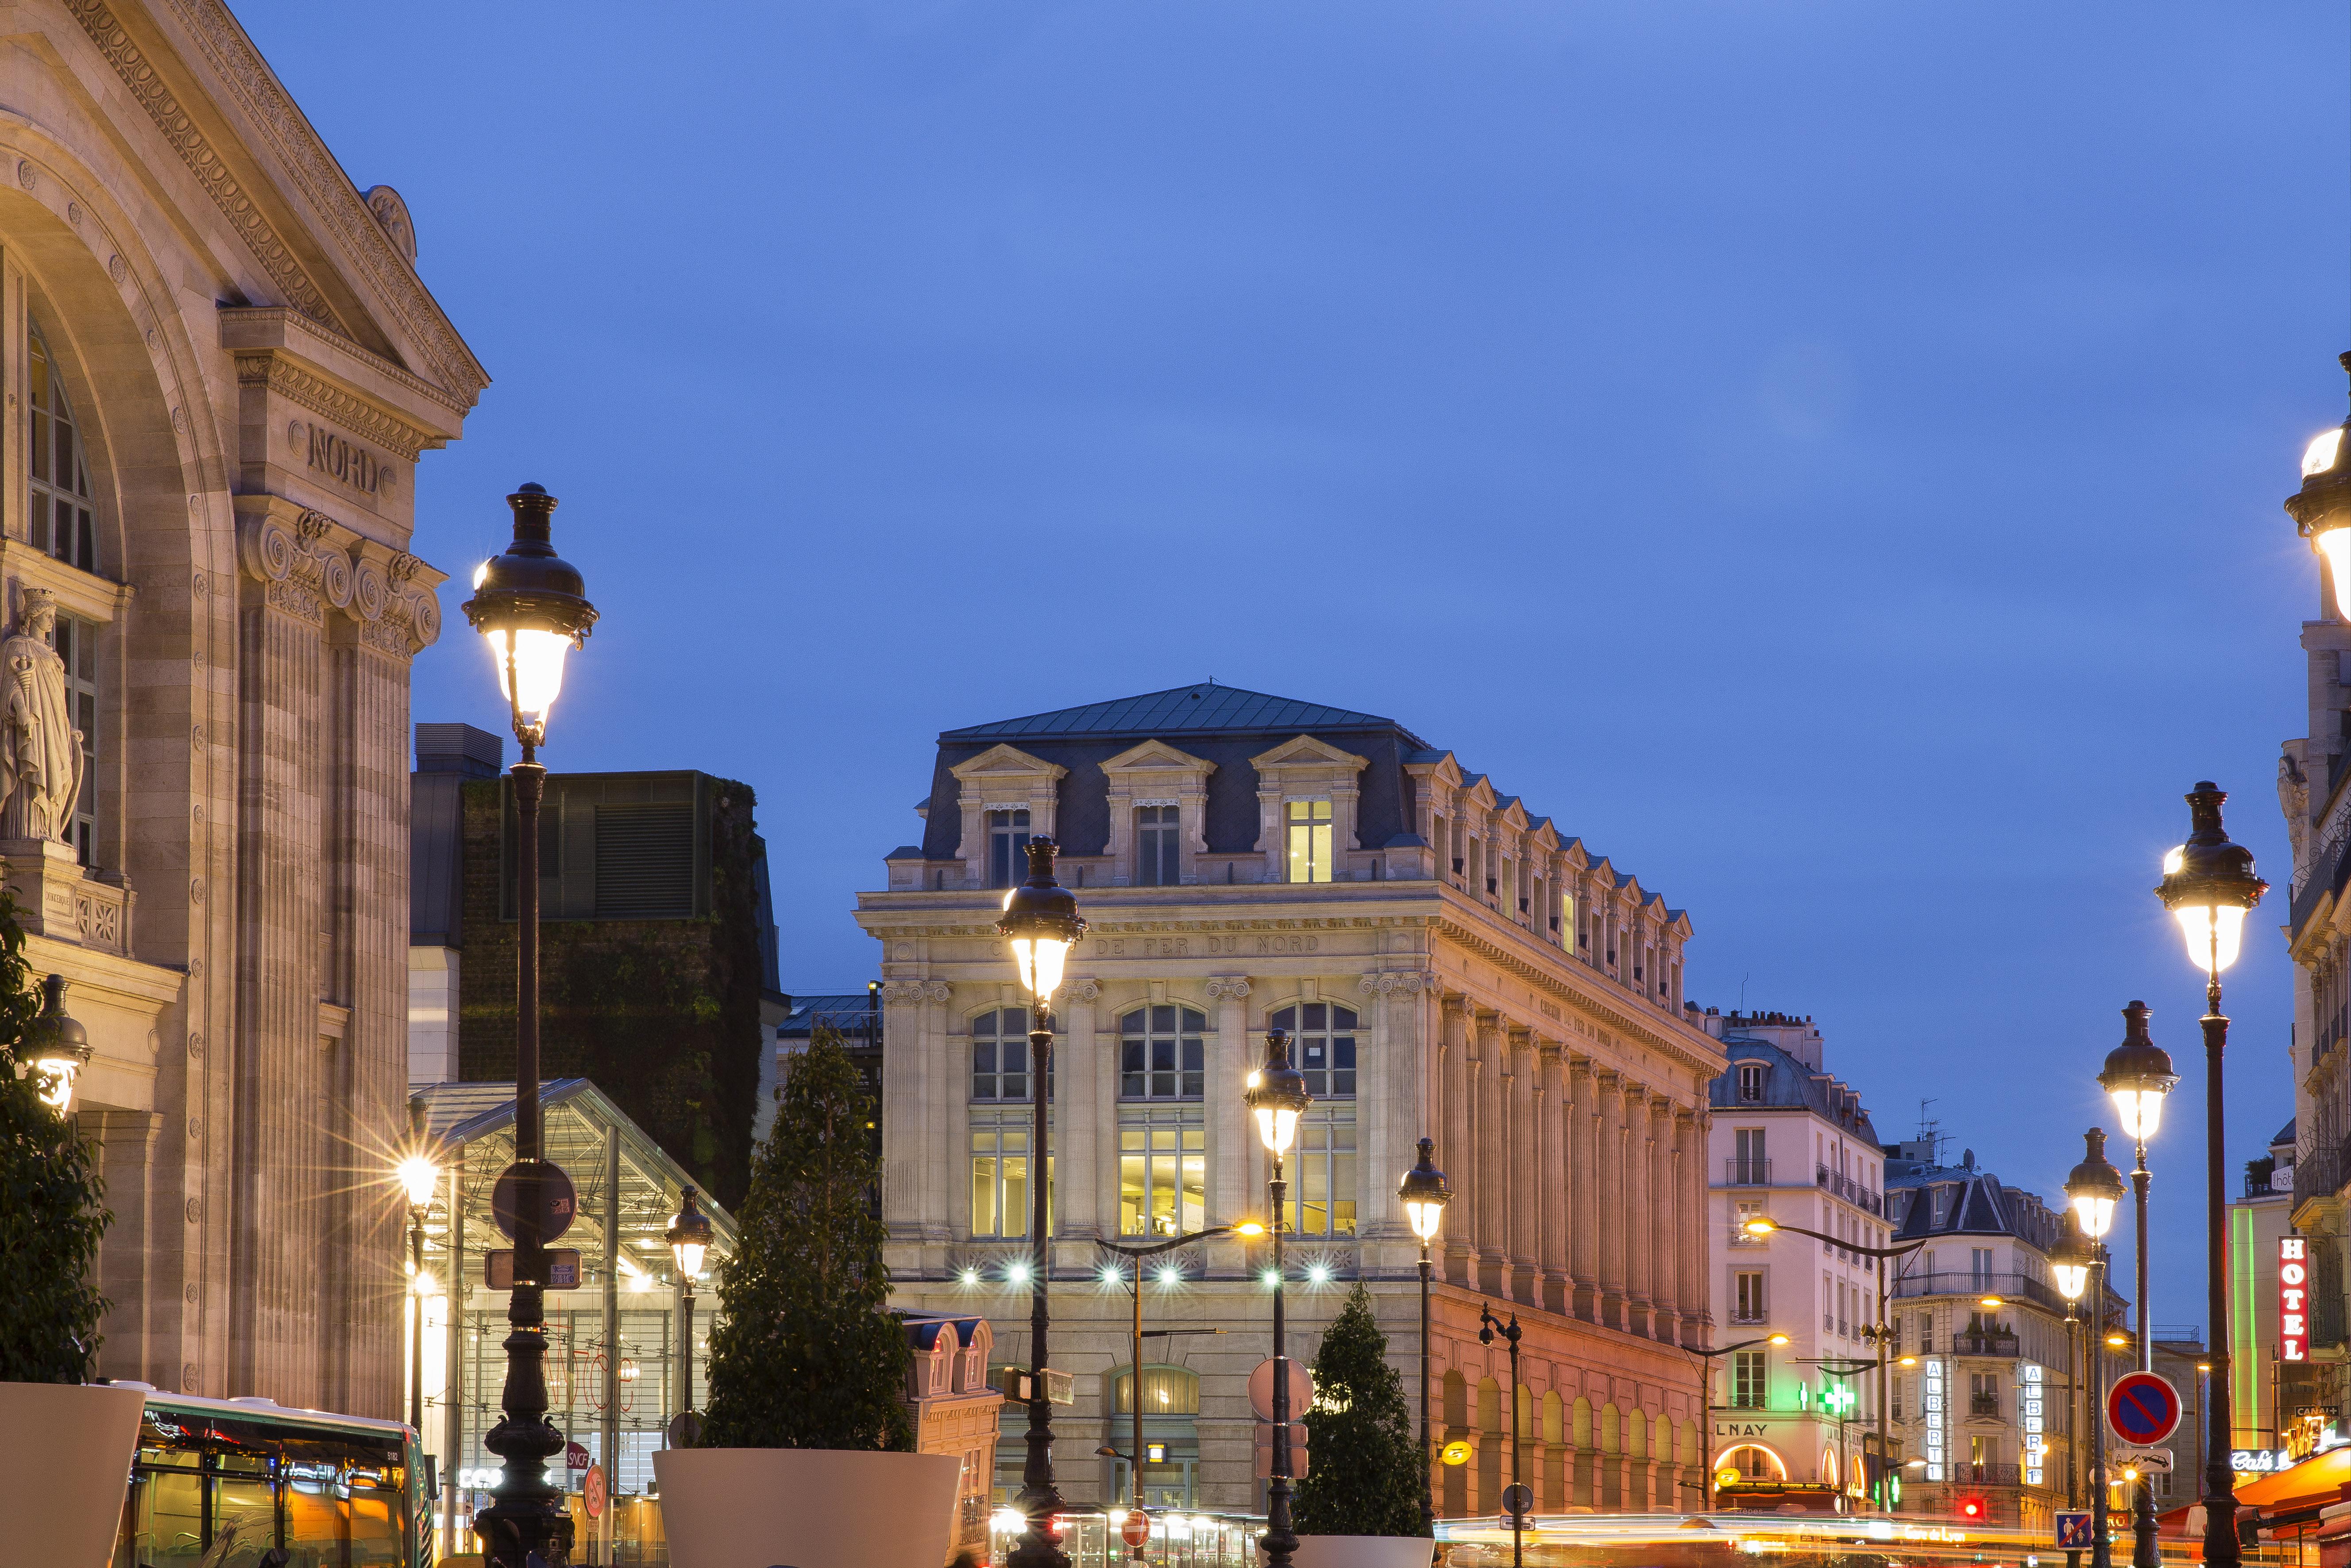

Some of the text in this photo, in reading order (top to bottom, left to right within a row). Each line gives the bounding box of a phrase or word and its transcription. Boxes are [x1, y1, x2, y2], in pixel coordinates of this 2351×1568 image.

[307, 423, 378, 492] NORD
[1096, 936, 1318, 956] DE FER DU NORD
[1540, 998, 1561, 1022] CHEMIN
[1574, 1016, 1585, 1035] FER
[1587, 1023, 1595, 1040] DU
[1597, 1028, 1611, 1047] NORD
[2282, 1239, 2305, 1360] HOTEL
[1929, 1363, 1939, 1460] ALBERT
[2028, 1368, 2040, 1465] ALBERT
[387, 1452, 398, 1460] 5182
[567, 1452, 588, 1466] SNCF
[2231, 1450, 2273, 1471] Café
[1905, 1524, 1927, 1540] Gare
[1929, 1528, 1940, 1541] de
[1942, 1526, 1965, 1543] Lyon
